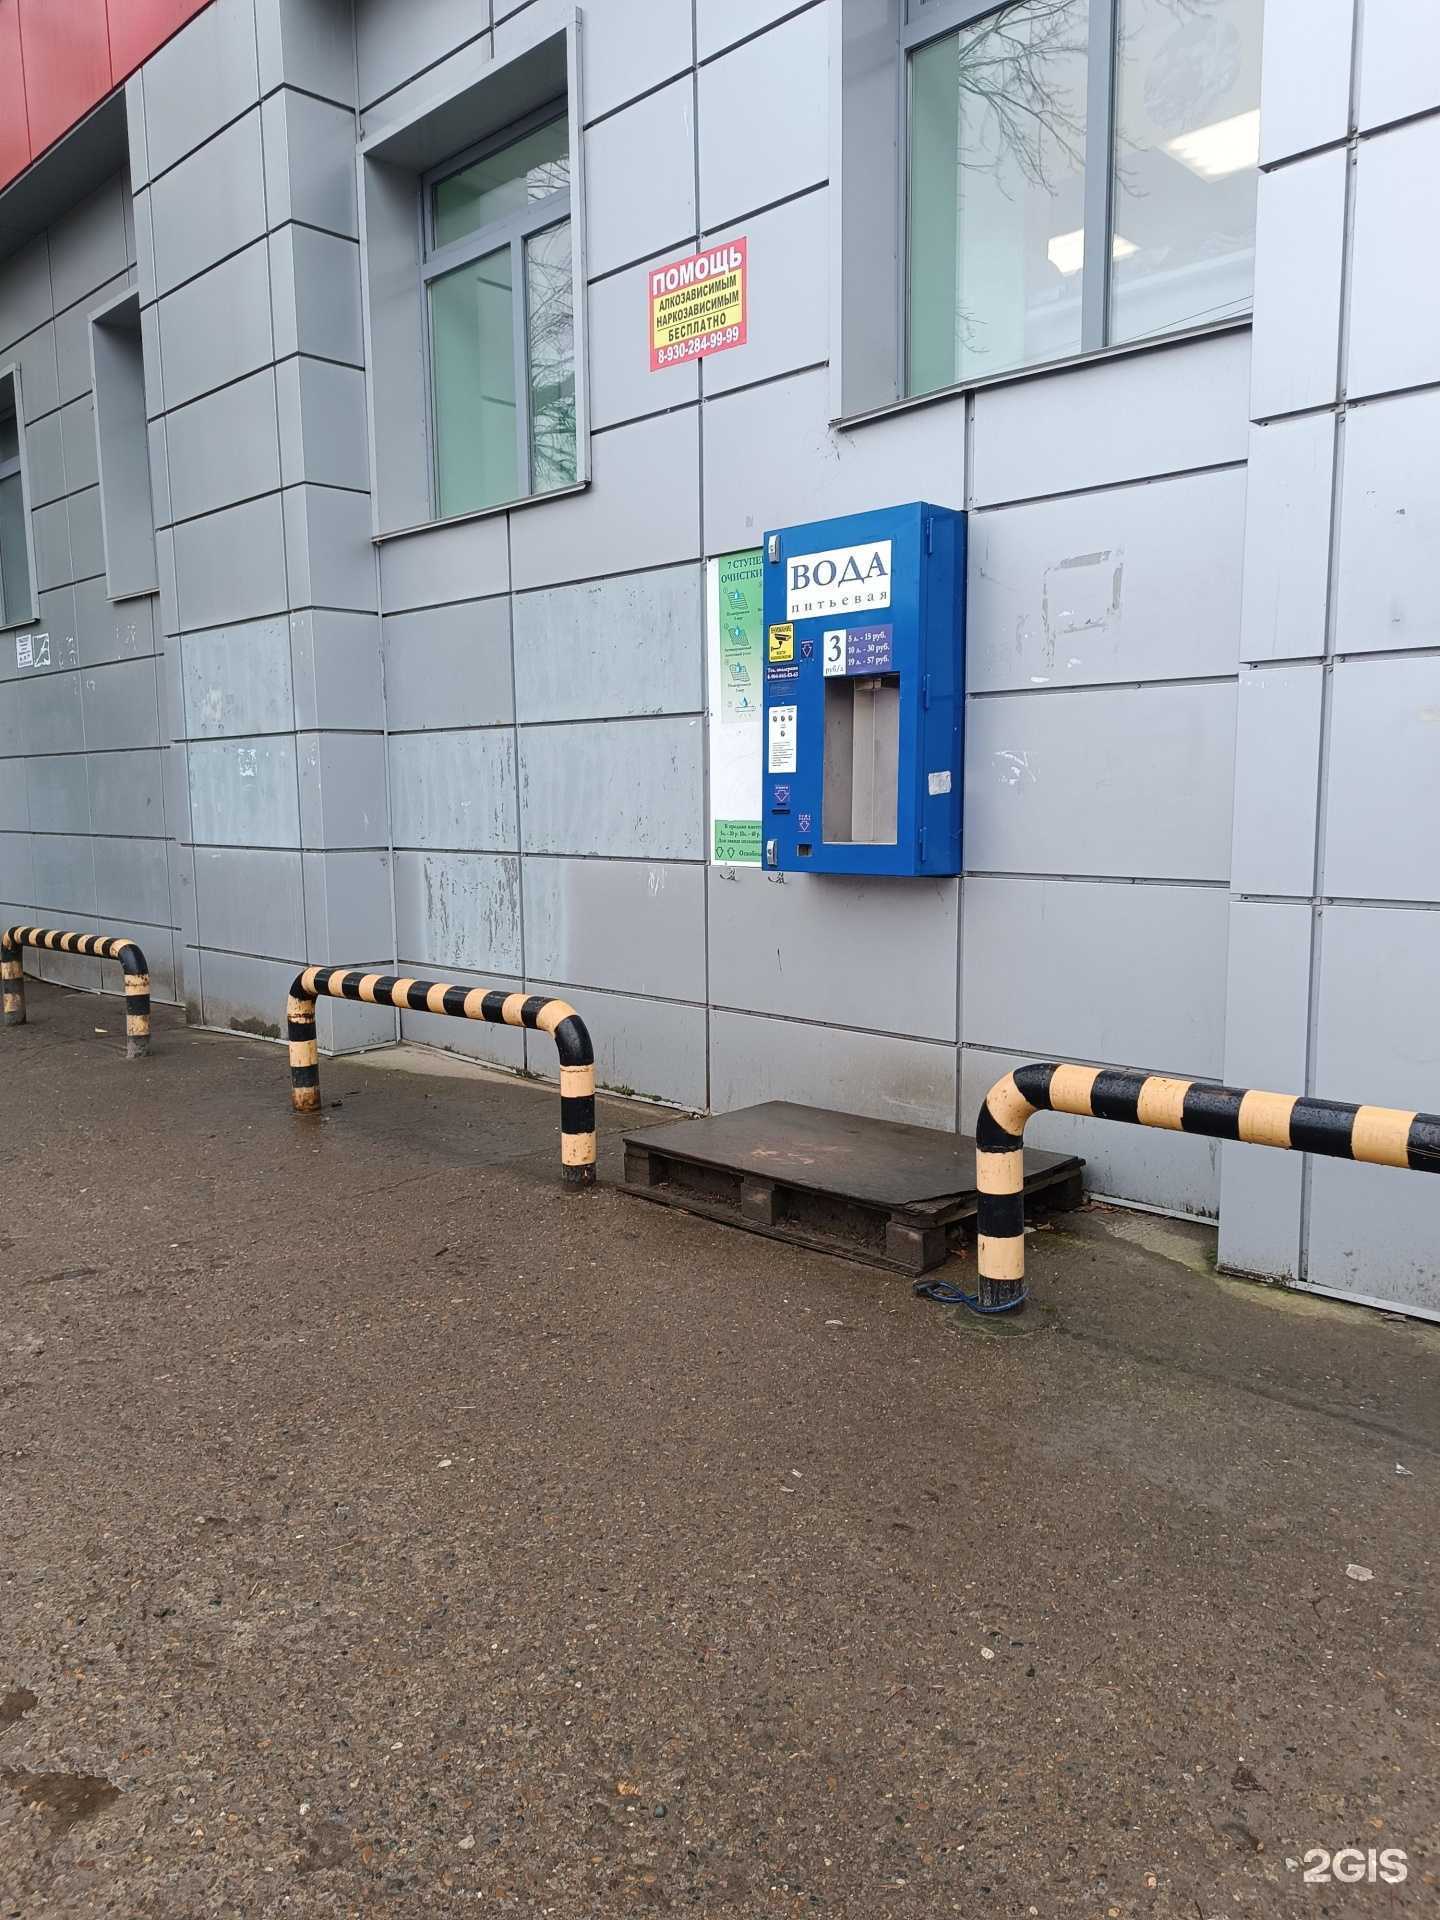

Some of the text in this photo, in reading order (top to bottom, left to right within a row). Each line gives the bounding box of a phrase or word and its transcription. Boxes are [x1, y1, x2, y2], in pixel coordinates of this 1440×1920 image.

[652, 246, 742, 296] ПОМОЩЬ
[659, 274, 737, 313] АЛКОЗАВИСИМЫМ
[656, 290, 739, 328] НАРКОЗАВИСИМЫМ
[668, 312, 727, 342] БЕСПЛАТНО
[657, 326, 739, 364] 8-930-284-99-99
[721, 569, 763, 583] ОЧИСТКИ
[728, 556, 764, 569] 7 СТУПЕ
[790, 551, 888, 591] ВОДА
[791, 591, 887, 613] питьевая
[828, 635, 842, 662] 3
[864, 632, 872, 640] 15
[866, 656, 874, 664] 57
